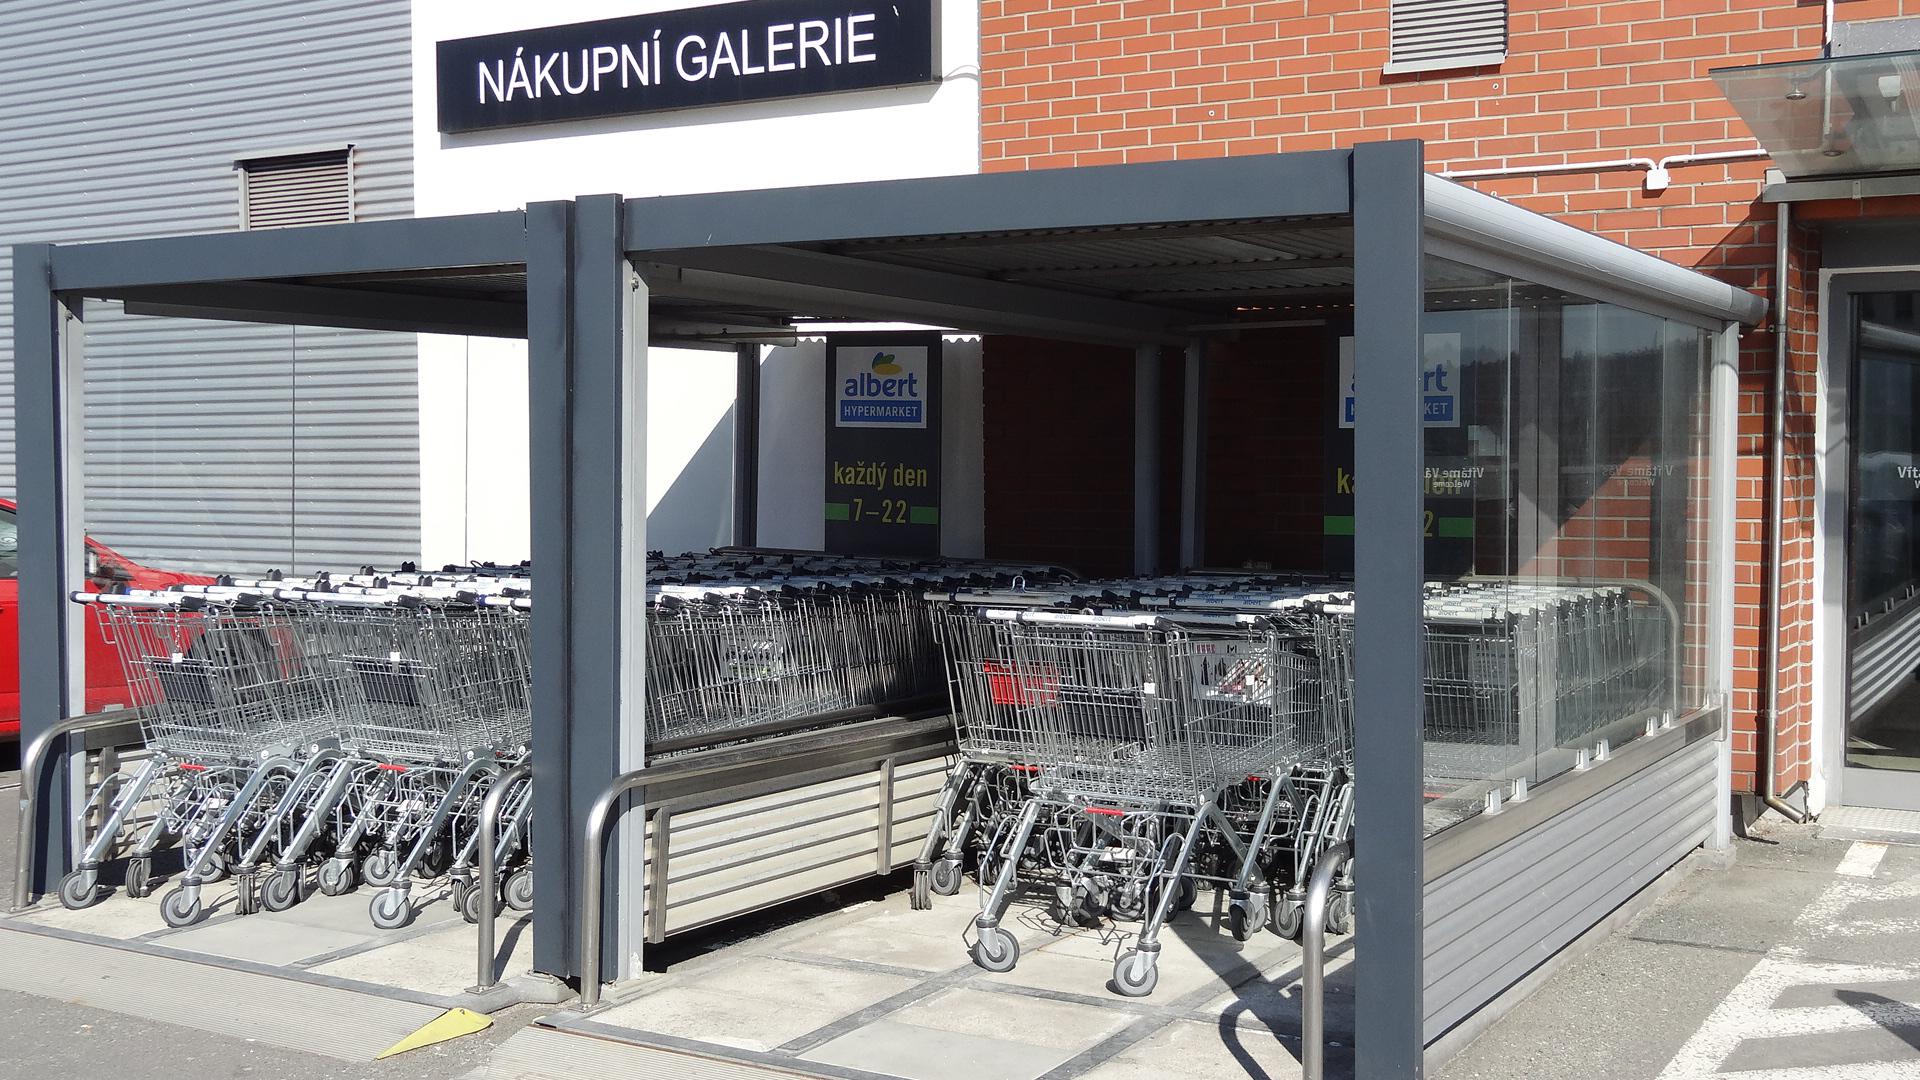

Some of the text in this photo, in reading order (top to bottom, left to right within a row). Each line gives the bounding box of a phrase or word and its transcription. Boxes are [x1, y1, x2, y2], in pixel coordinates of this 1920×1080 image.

[479, 13, 876, 104] NÁKUPNÍ GALERIE
[845, 373, 918, 398] albert
[844, 405, 918, 417] HYPERMARKET
[834, 461, 927, 490] každý den
[1897, 466, 1920, 478] Vít
